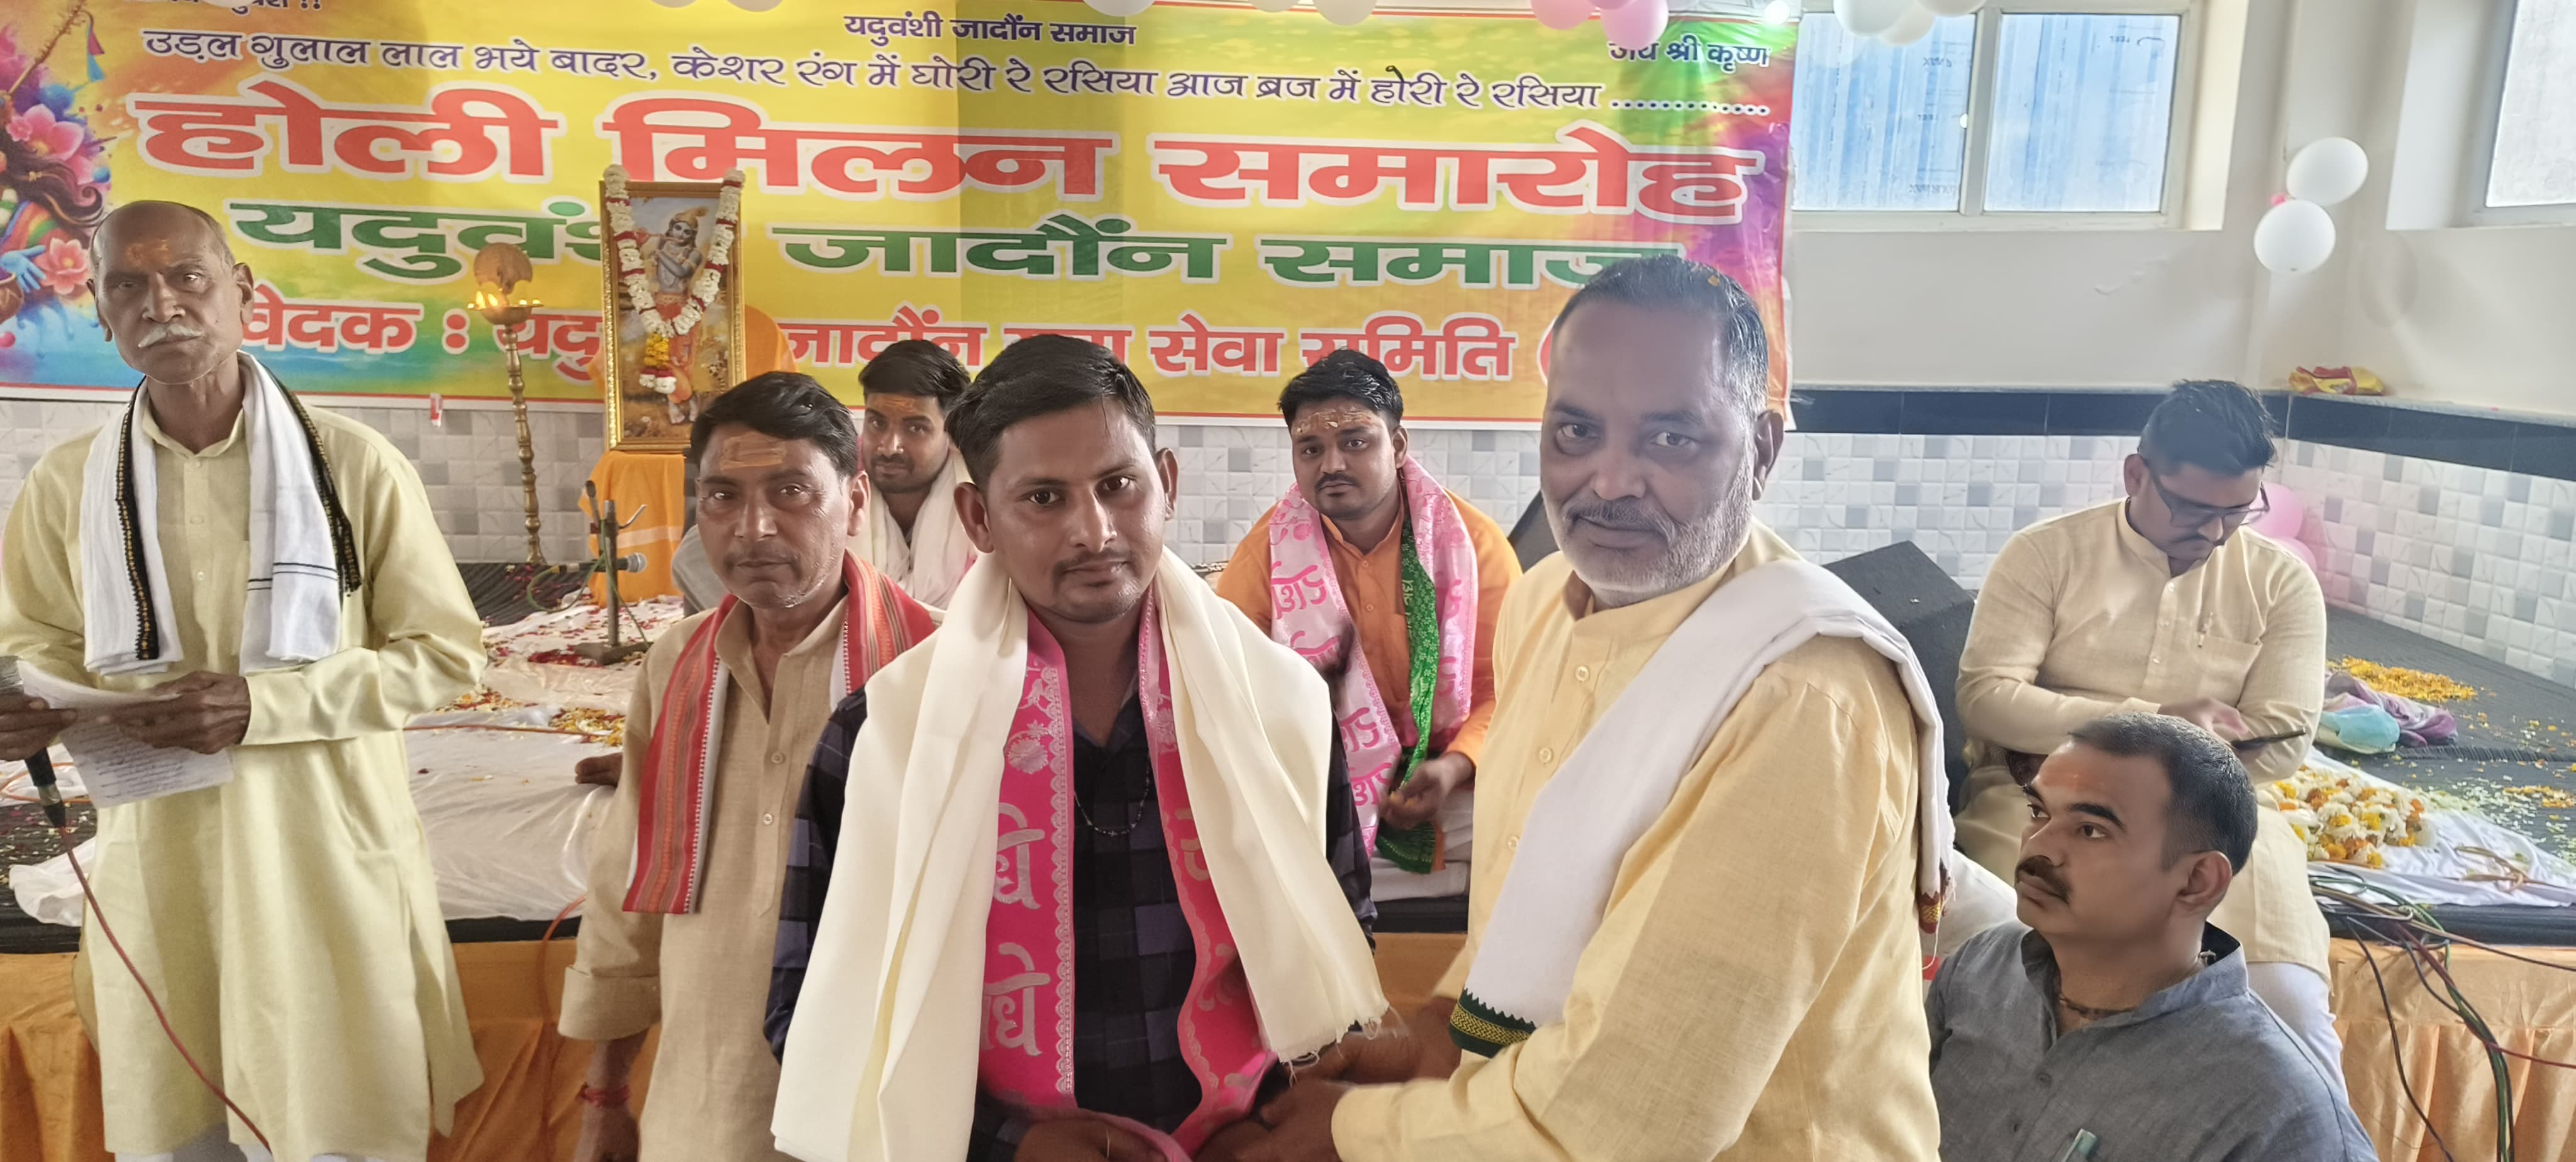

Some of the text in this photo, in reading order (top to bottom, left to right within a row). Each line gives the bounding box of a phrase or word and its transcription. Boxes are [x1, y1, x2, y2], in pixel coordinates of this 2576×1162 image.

[844, 10, 1136, 46] यदुवंशी जादौंन समाज
[1667, 35, 1701, 60] श्री
[1707, 44, 1769, 71] कृष्ण
[251, 35, 371, 69] गुलाल
[381, 42, 464, 69] लाल
[474, 39, 540, 71] भये
[672, 47, 786, 86] केशर
[797, 52, 857, 86] रंग
[869, 54, 900, 86] में
[1006, 58, 1031, 92] रे
[1043, 60, 1158, 94] रसिया
[1168, 73, 1247, 97] आज
[1257, 76, 1321, 99] ब्रज
[1328, 70, 1361, 101] में
[1371, 65, 1448, 105] होरी
[1454, 72, 1483, 108] रे
[1492, 76, 1602, 108] रसिया
[135, 82, 1756, 218] होली मिलन समारोह
[230, 202, 602, 277] यदुवंश
[773, 214, 1227, 279] जादौंन
[1150, 314, 1285, 372] सेवा
